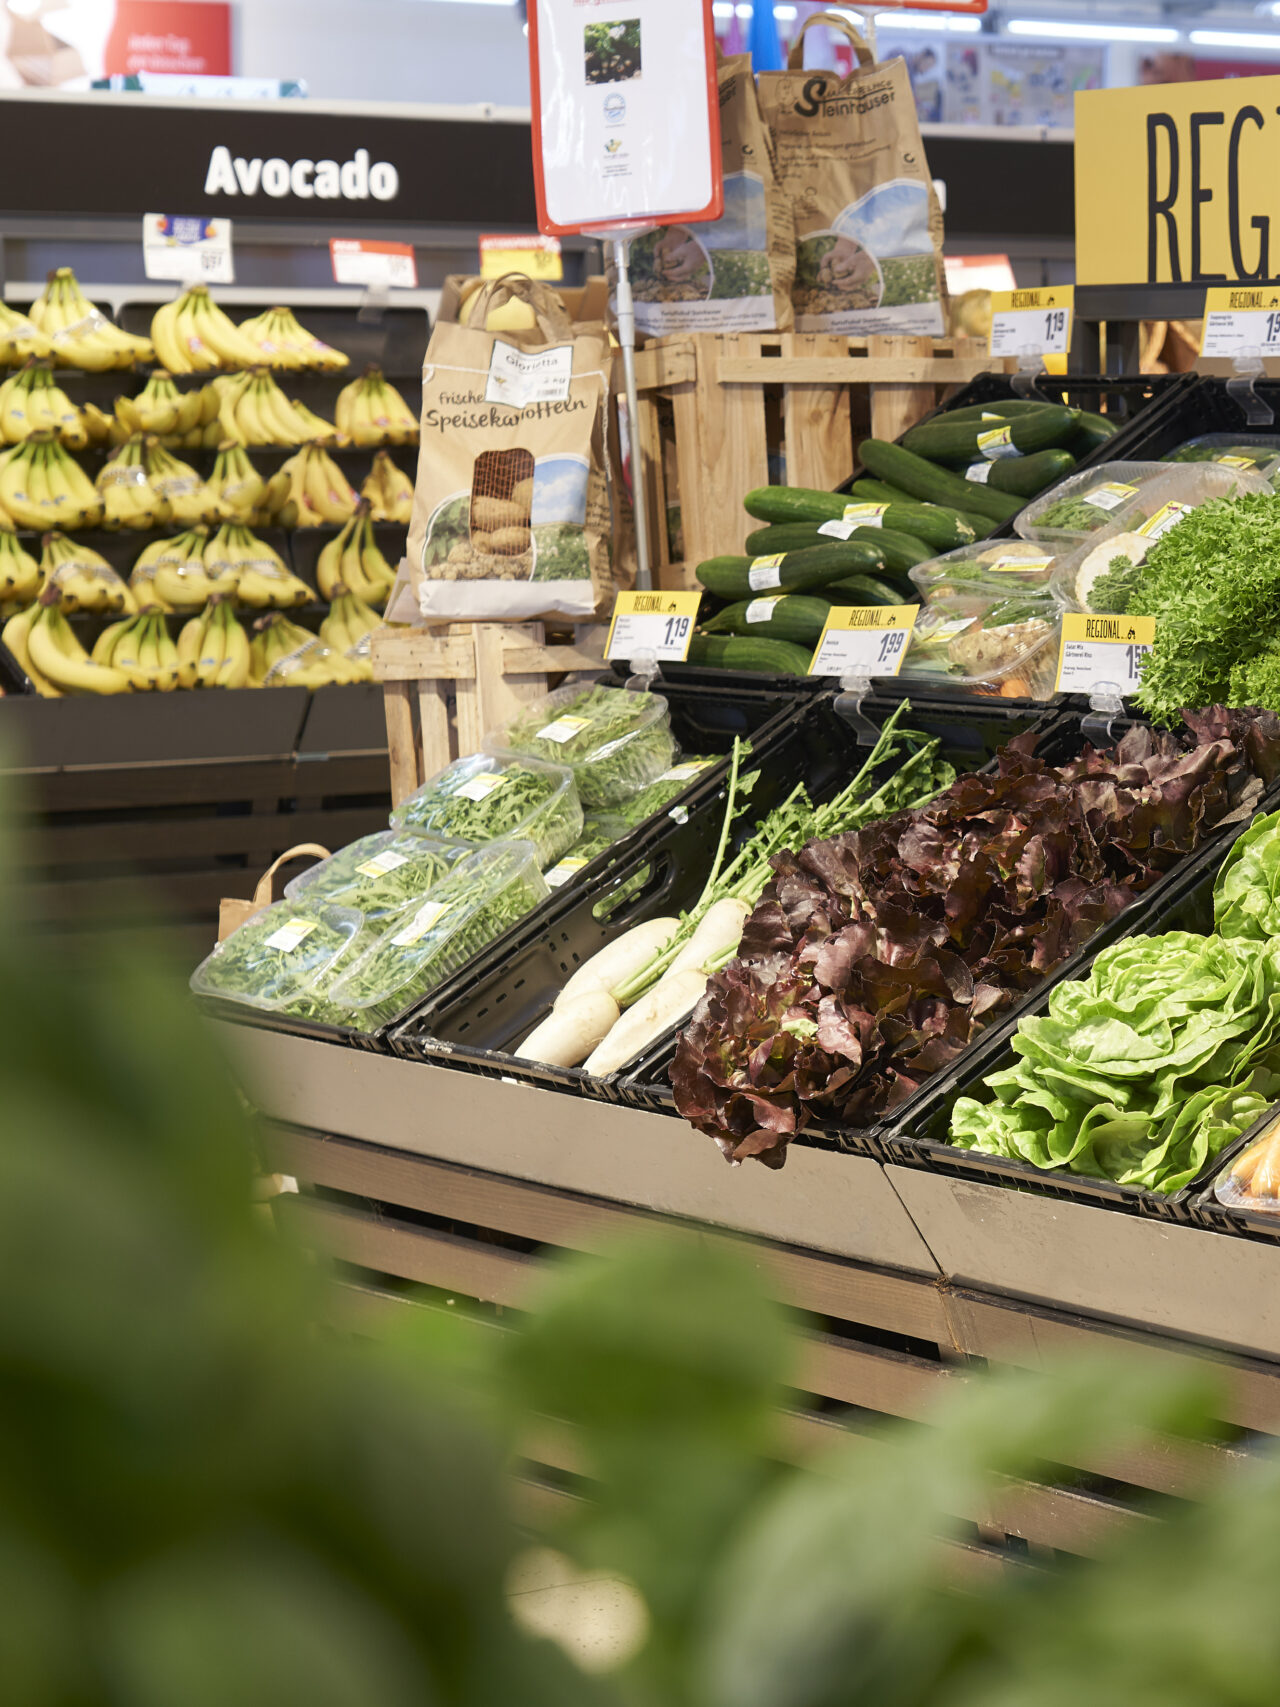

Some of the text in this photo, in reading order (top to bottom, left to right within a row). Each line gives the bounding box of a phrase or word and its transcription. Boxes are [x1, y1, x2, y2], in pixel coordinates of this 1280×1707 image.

[204, 146, 399, 201] Avocado
[1011, 291, 1041, 308] REGIONAL
[1229, 292, 1263, 308] REGIONAL
[1045, 312, 1065, 341] 1.19
[505, 354, 559, 371] Glorietta
[633, 595, 663, 612] REGIONAL
[849, 609, 882, 627] REGIONAL
[664, 617, 690, 646] 1.19
[1086, 619, 1121, 640] REGIONAL
[877, 632, 905, 663] 1.99
